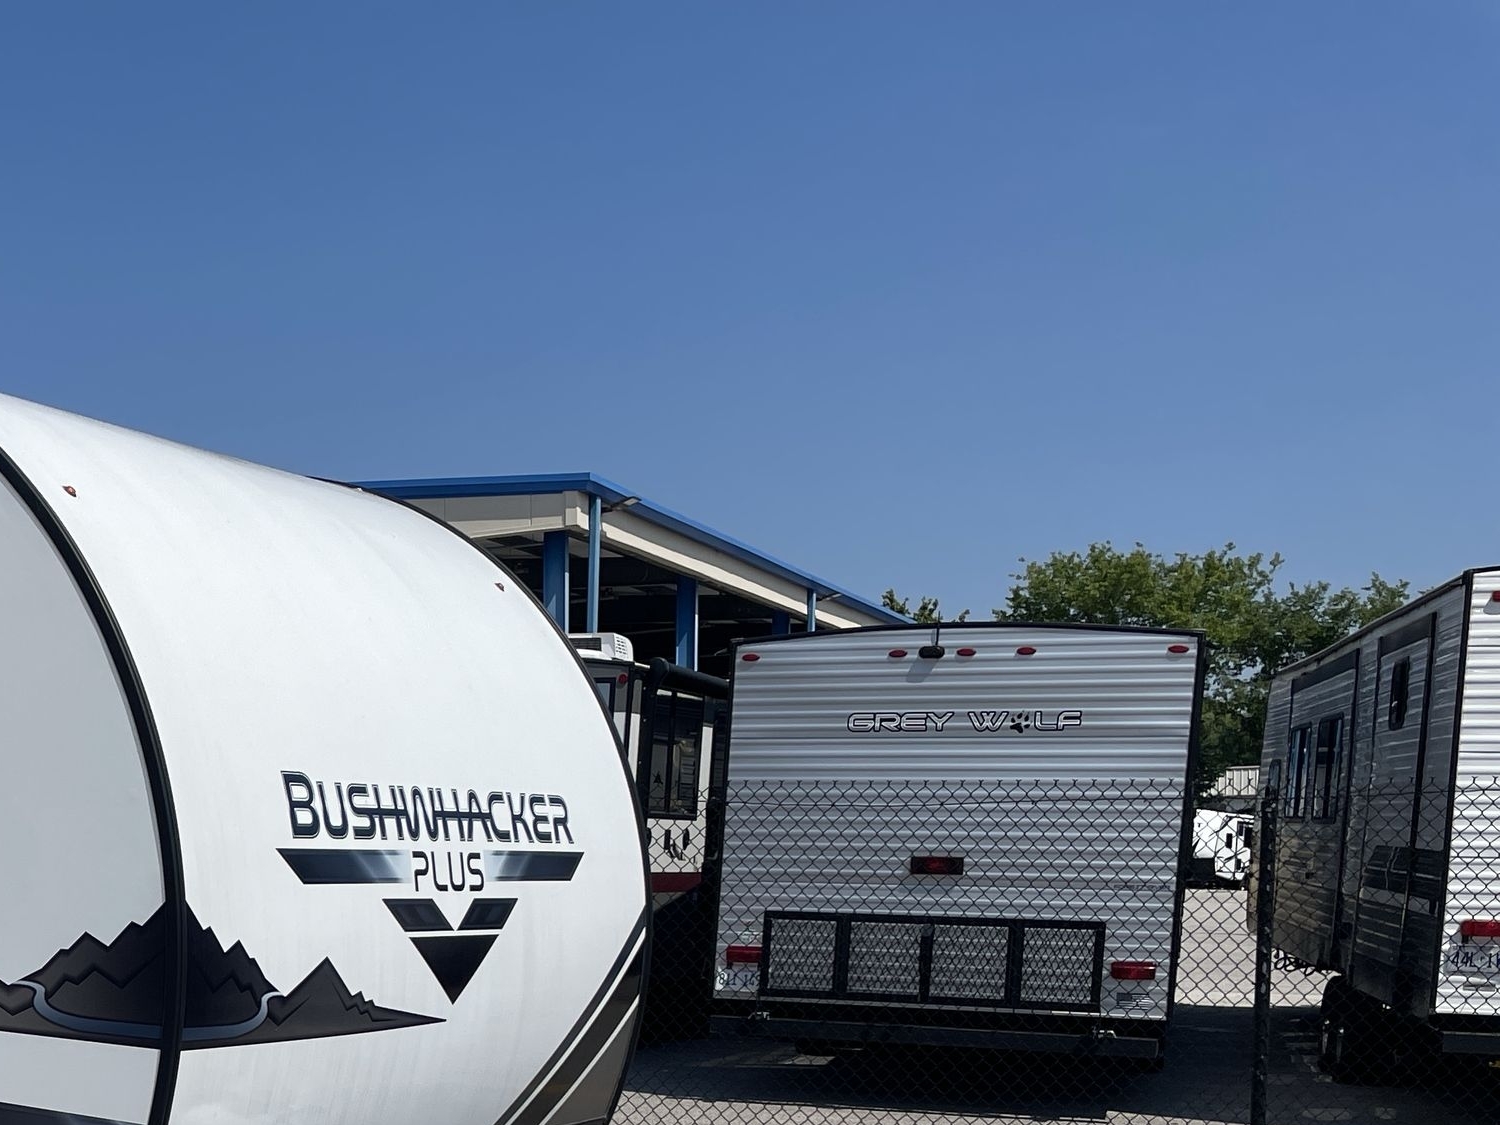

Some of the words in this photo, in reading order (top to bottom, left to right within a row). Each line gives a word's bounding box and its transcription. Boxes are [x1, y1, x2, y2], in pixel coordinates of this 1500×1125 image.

[847, 712, 954, 733] GREY
[968, 711, 1082, 733] WLF
[280, 769, 575, 845] BUSHWHACKER
[411, 850, 485, 892] PLUS
